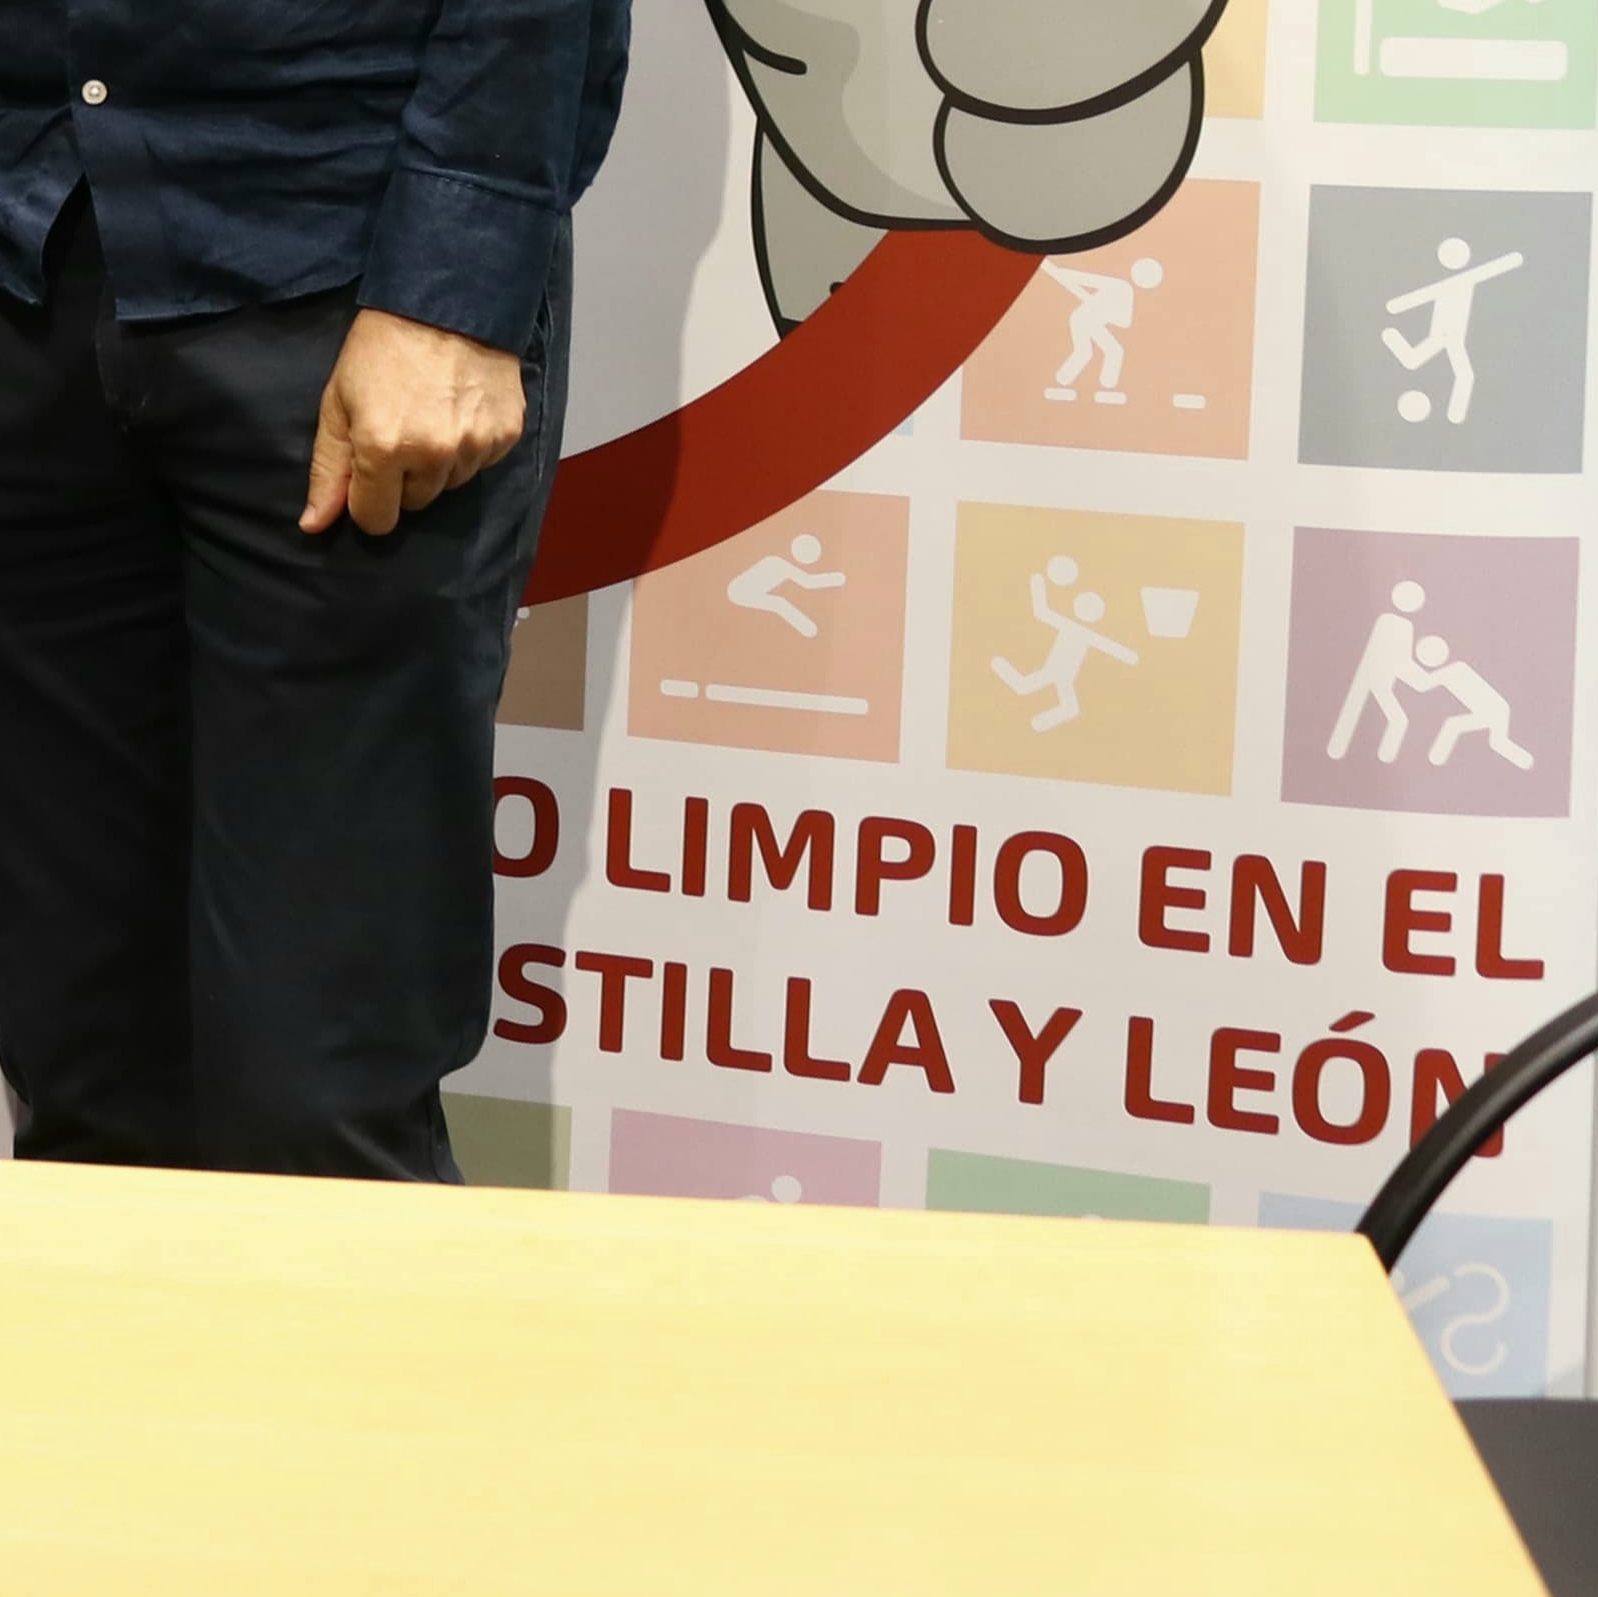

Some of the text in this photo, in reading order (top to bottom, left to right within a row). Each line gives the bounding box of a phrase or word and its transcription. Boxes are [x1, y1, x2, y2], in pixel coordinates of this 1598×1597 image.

[605, 786, 1089, 937] LIMPIO
[1137, 844, 1328, 967] EN
[1382, 868, 1545, 981] EL
[493, 942, 1509, 1158] STILLA Y LEÓN
